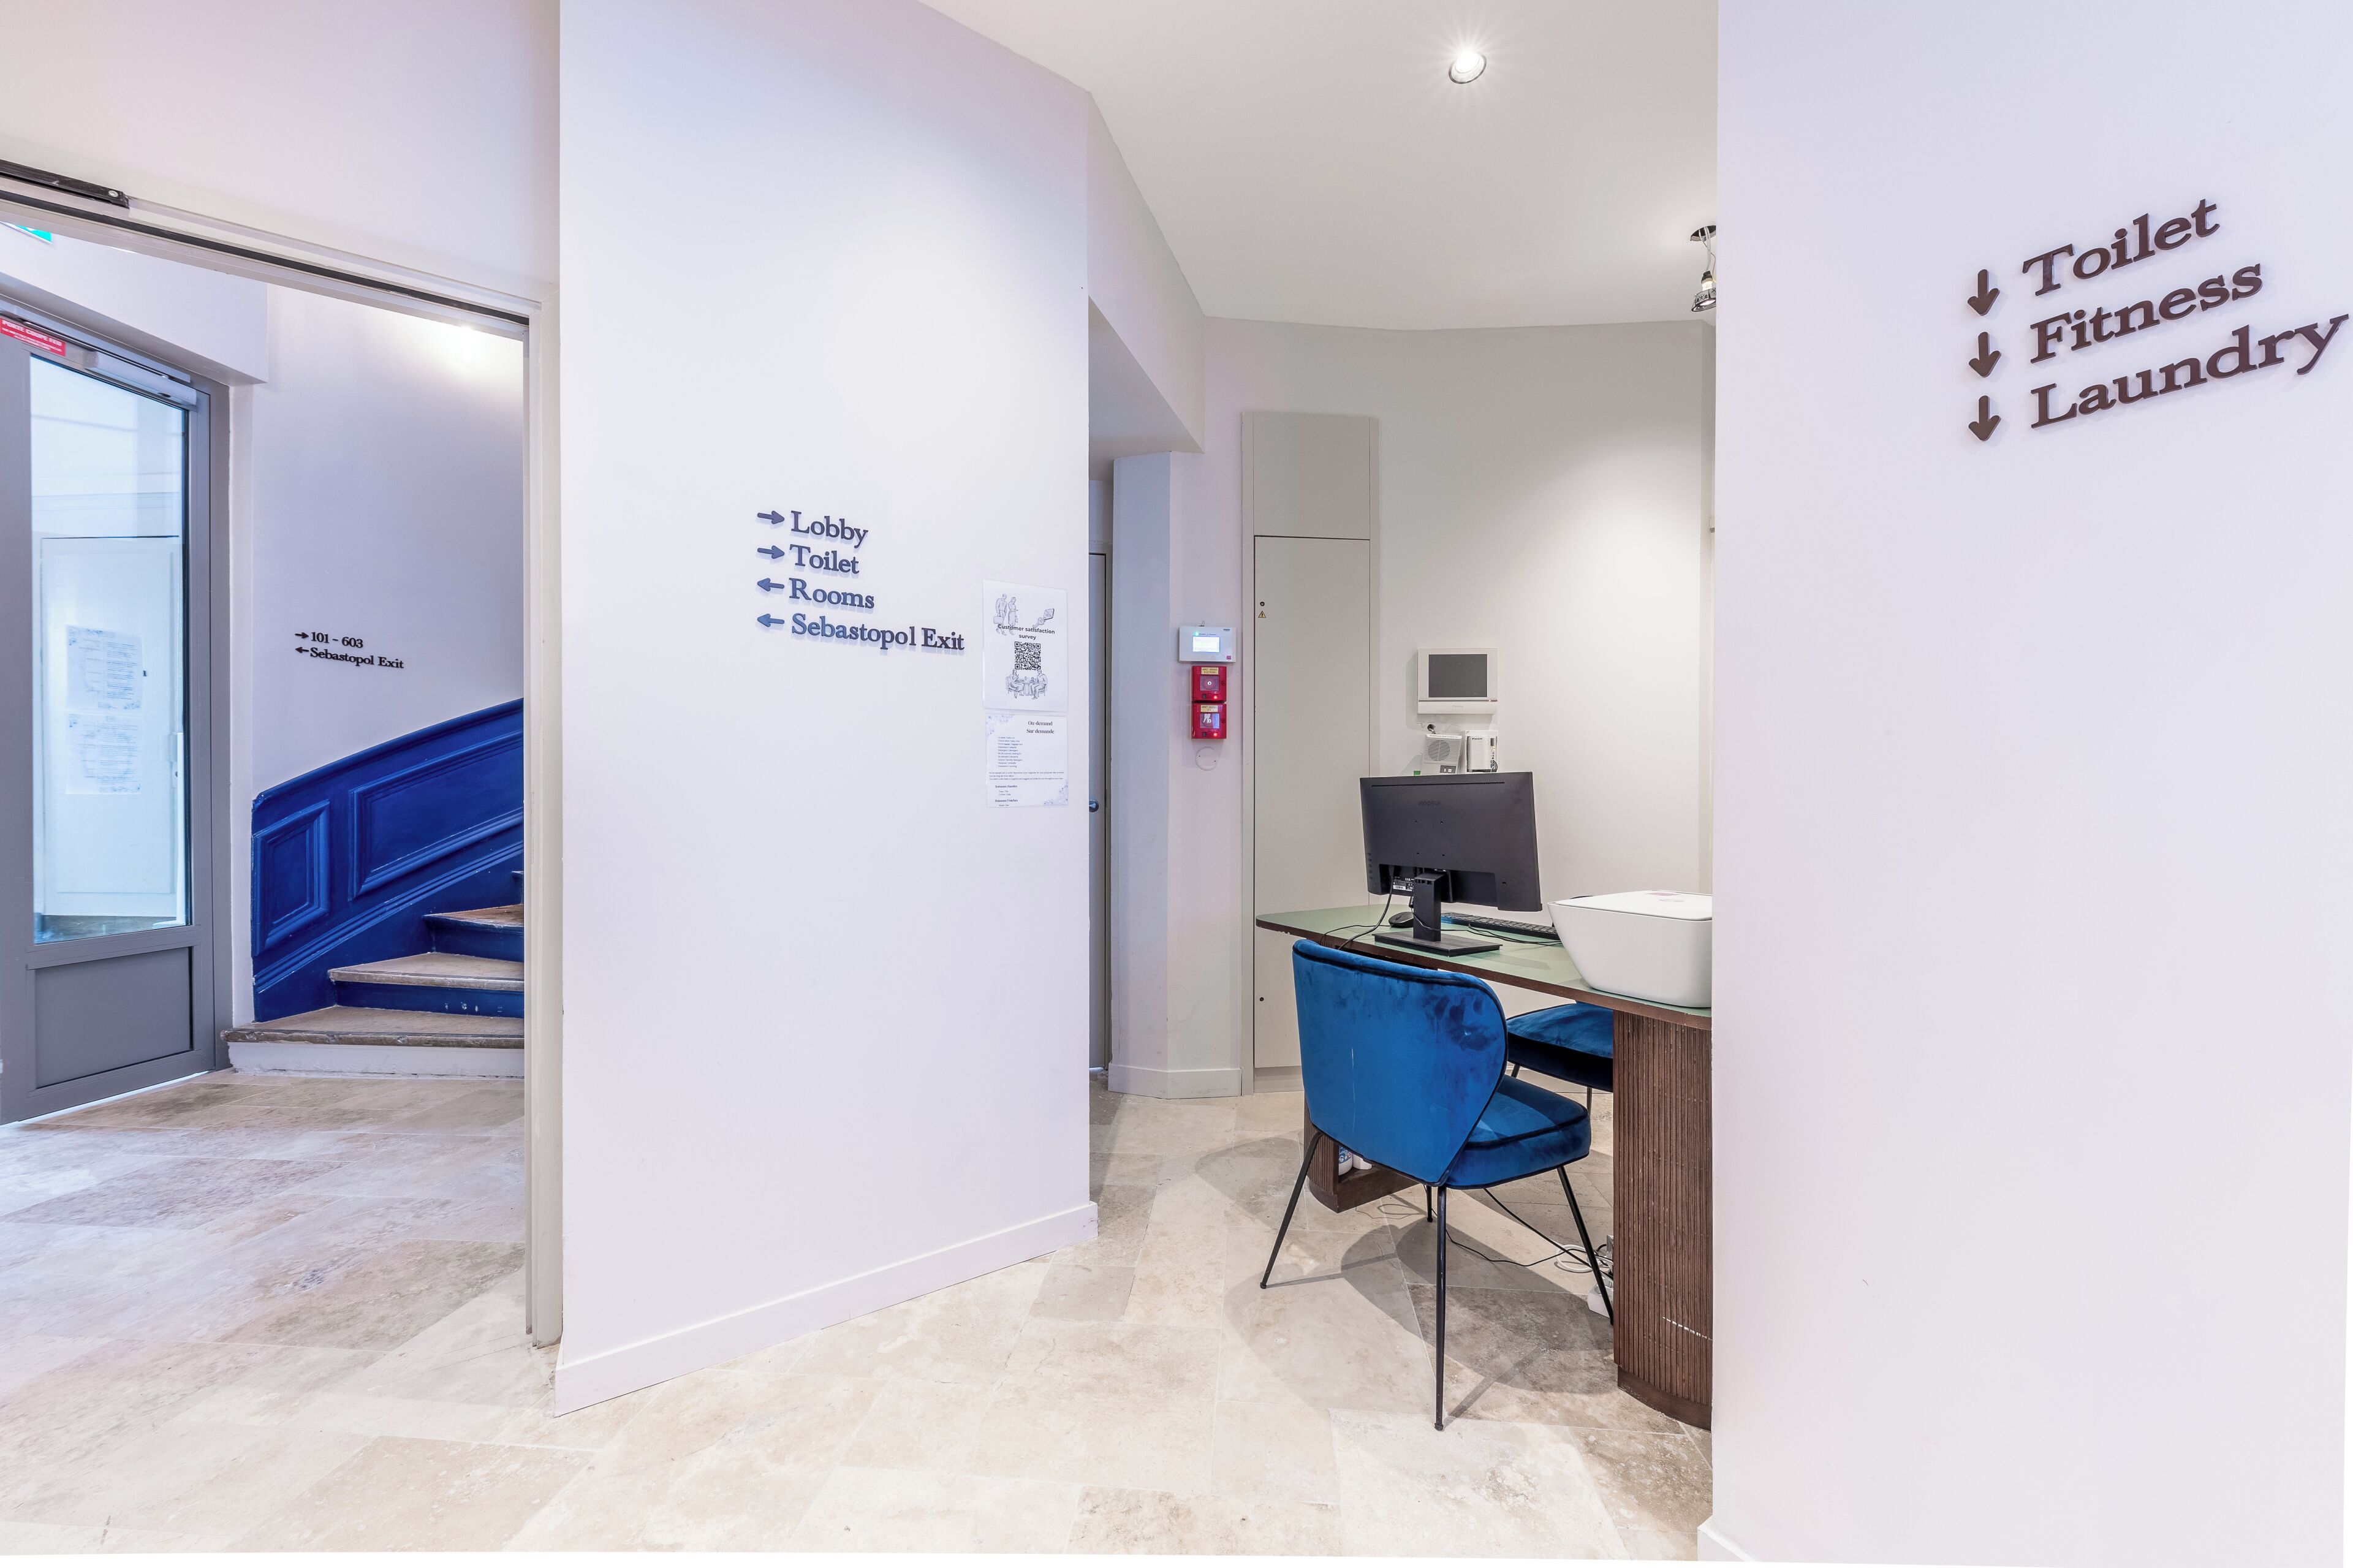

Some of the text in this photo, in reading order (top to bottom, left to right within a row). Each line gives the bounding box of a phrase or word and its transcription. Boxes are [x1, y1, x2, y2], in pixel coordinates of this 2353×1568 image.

[2021, 198, 2221, 297] Toilet
[2030, 263, 2263, 364] Fitness
[2031, 314, 2349, 430] Laundry
[790, 510, 868, 548] Lobby
[789, 544, 860, 574] Toilet
[789, 578, 874, 608] Rooms
[311, 632, 329, 643] 101
[342, 637, 363, 648] 603
[792, 613, 964, 650] Sebastopol Exit
[310, 647, 404, 668] Sebastopol Exit
